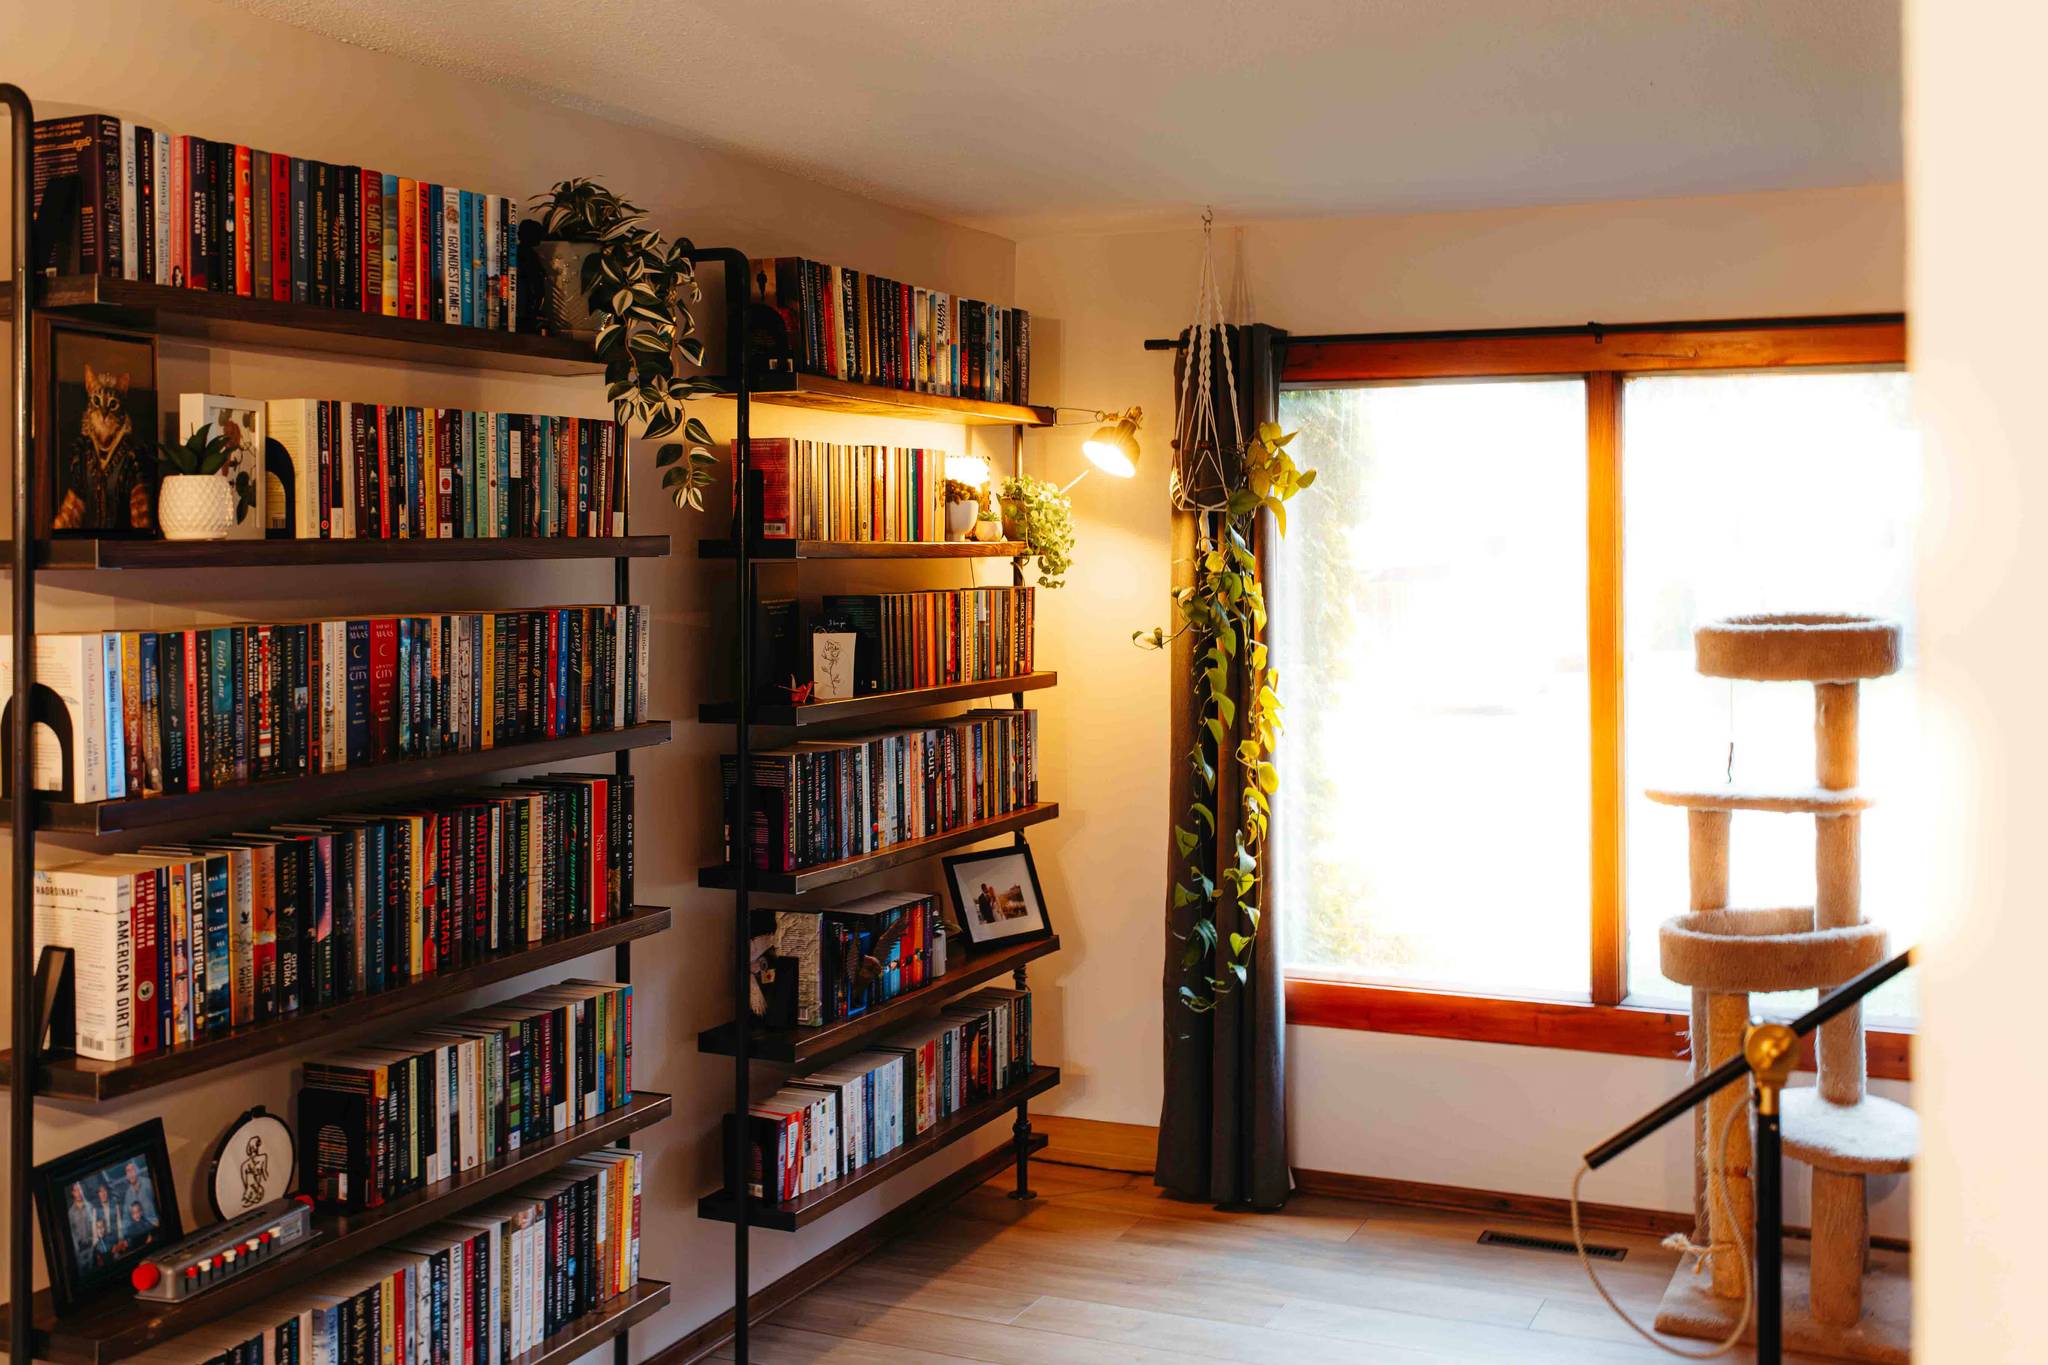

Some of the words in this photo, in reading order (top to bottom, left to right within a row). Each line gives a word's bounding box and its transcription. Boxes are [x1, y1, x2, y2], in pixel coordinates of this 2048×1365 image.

[367, 203, 382, 245] GAMES
[368, 249, 382, 295] UNTOLD
[447, 235, 460, 283] GRANDEST
[448, 286, 460, 311] GAME
[848, 327, 856, 363] PENNY
[217, 639, 227, 672] Firefly
[518, 639, 528, 654] THE
[218, 674, 226, 699] Lane
[518, 657, 528, 680] FINAL
[518, 682, 528, 711] GAMBIT
[519, 805, 529, 820] THE
[441, 816, 451, 878] ROBERT
[476, 813, 487, 864] WATCH
[519, 824, 528, 874] DAYDREAMS
[191, 872, 203, 909] HELLO
[475, 877, 487, 921] GIRLS
[192, 913, 204, 978] BEAUTIFUL
[441, 908, 451, 955] CRAIS
[116, 919, 129, 993] AMERICAN
[117, 999, 130, 1029] DIRT
